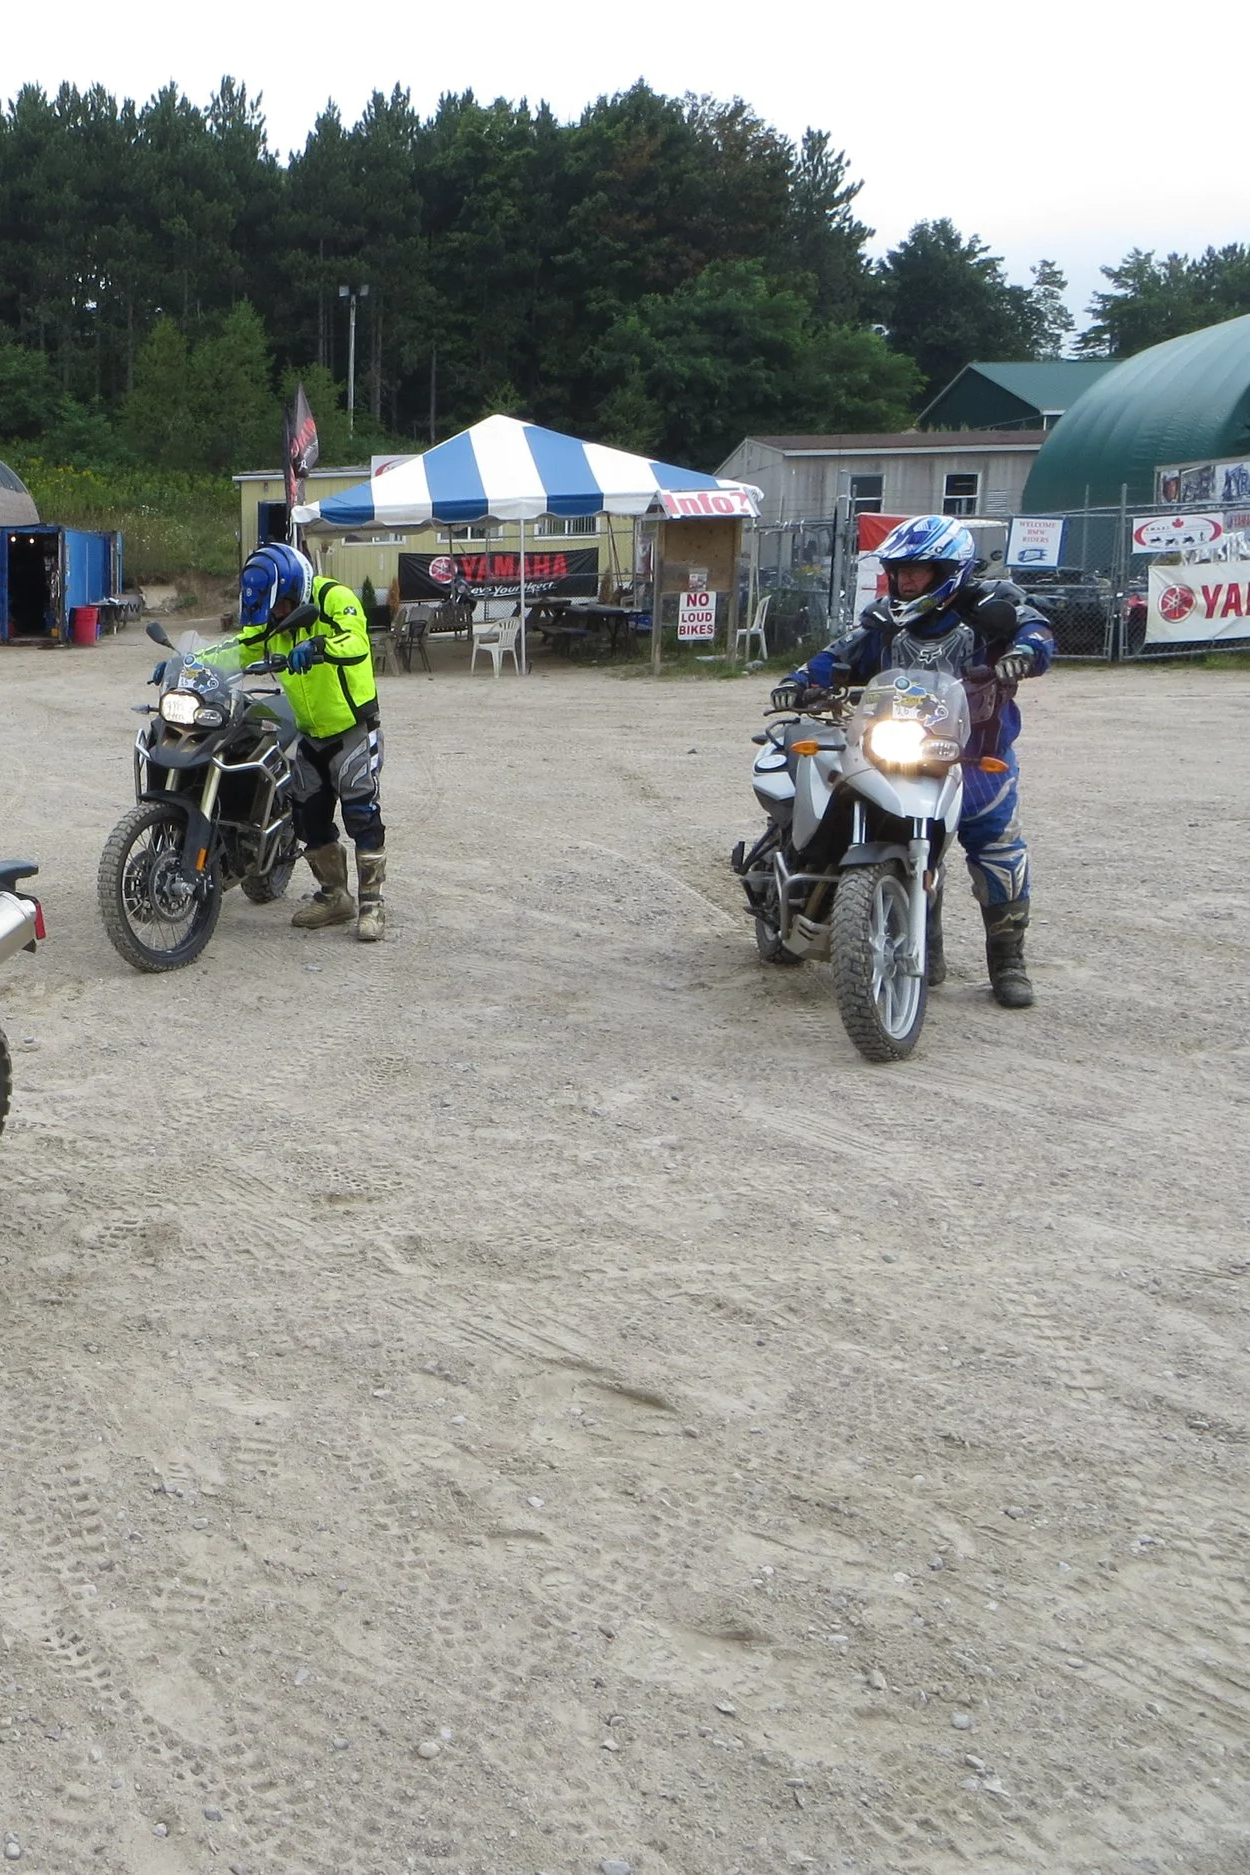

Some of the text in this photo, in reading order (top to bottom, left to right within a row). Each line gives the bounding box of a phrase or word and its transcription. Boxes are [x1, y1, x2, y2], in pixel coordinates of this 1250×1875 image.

[661, 491, 750, 514] Info?
[461, 554, 568, 581] YAMAHA
[686, 592, 710, 607] NO
[1201, 581, 1250, 619] YA
[681, 612, 713, 623] LOUD
[679, 624, 714, 635] BIKES
